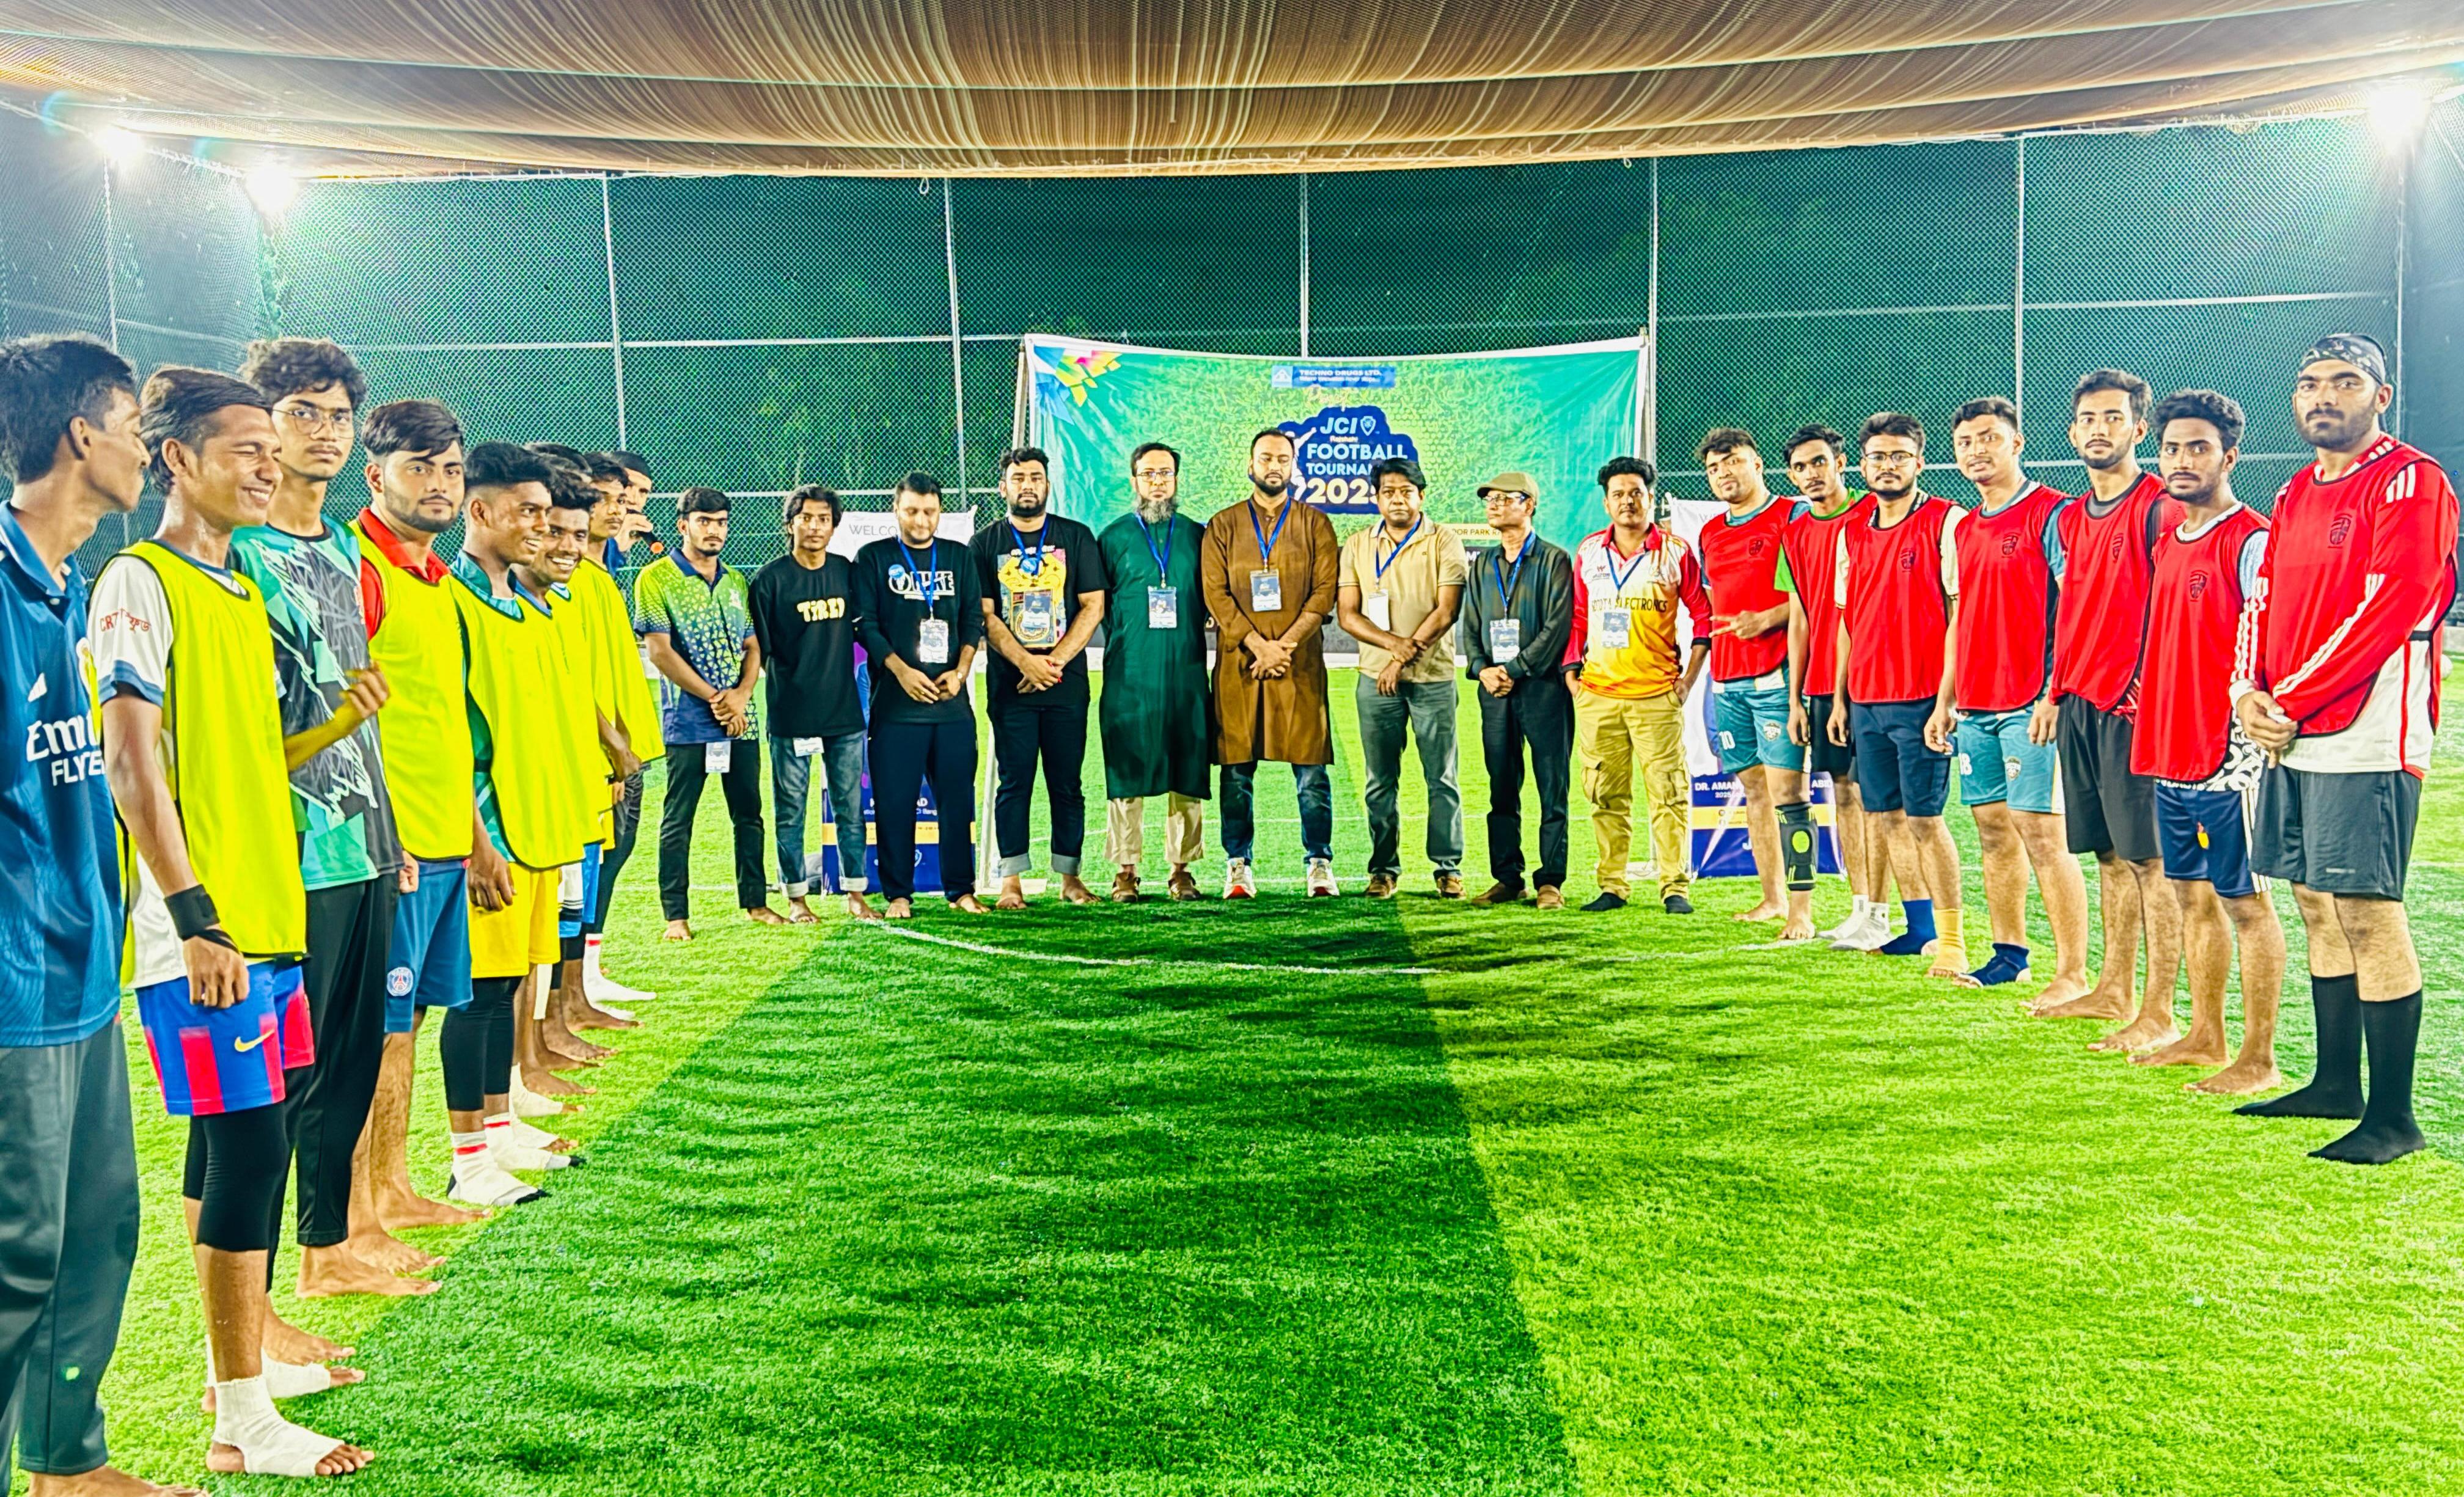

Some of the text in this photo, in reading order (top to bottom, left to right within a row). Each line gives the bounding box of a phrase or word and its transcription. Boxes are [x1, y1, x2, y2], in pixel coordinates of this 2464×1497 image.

[1320, 417, 1358, 434] JCI
[1307, 444, 1408, 460] FOOTBALL
[1306, 463, 1372, 475] TOURNA
[849, 524, 898, 536] WELCO
[100, 612, 119, 632] CR7
[1719, 731, 1736, 750] 10
[1695, 782, 1710, 791] DR.
